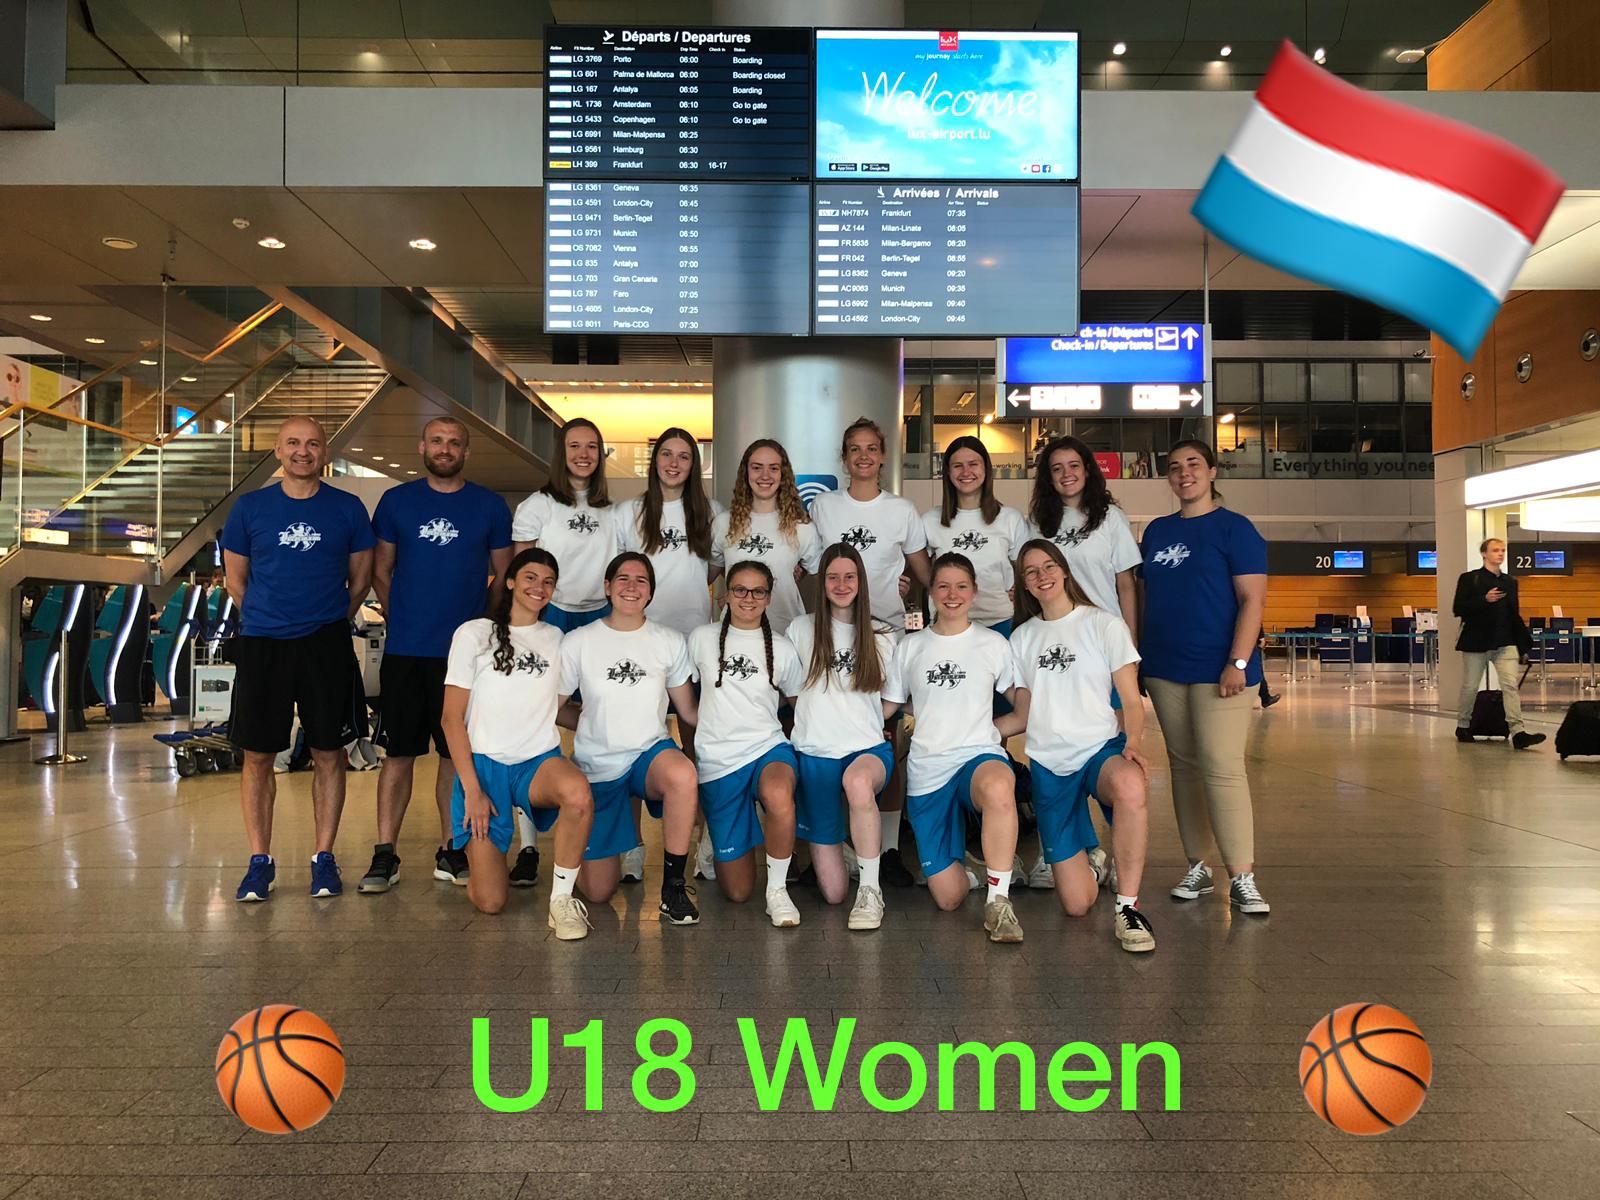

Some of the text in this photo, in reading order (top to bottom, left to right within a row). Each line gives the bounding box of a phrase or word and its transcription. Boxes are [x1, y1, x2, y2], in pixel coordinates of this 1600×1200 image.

[622, 31, 751, 45] Départs / Departures
[573, 55, 583, 63] LG
[733, 57, 762, 65] Boarding
[926, 53, 951, 61] journey
[614, 70, 634, 78] Palma
[636, 70, 644, 78] de
[646, 70, 674, 78] Mallorca
[733, 72, 762, 80] Boarding
[613, 85, 638, 94] Antalya
[733, 87, 762, 95] Boarding
[861, 71, 1037, 117] Welcome
[572, 115, 583, 123] LG
[613, 116, 655, 124] Copenhagen
[613, 131, 665, 139] Milan-Malpensa
[679, 131, 698, 139] 06:25
[613, 146, 644, 154] Hamburg
[679, 146, 698, 154] 06:30
[679, 161, 698, 169] 06:30
[893, 188, 999, 198] Arrivées / Arrivals
[613, 199, 653, 208] London-City
[613, 214, 652, 223] Berlin-Tegel
[613, 229, 637, 237] Munich
[572, 244, 584, 252] OS
[882, 240, 931, 248] Milan-Bergamo
[613, 259, 638, 268] Antalya
[680, 260, 698, 268] 07:00
[881, 255, 920, 263] Berlin-Tegel
[680, 275, 698, 283] 07:00
[881, 300, 933, 308] Milan-Malpensa
[614, 305, 653, 314] London-City
[881, 315, 920, 323] London-City
[679, 321, 698, 329] 07:30
[1080, 326, 1107, 338] ck-in
[1112, 326, 1154, 340] Départs
[1051, 339, 1094, 351] Check-in
[1100, 339, 1154, 352] Departures
[993, 462, 1022, 470] -working
[1273, 457, 1435, 475] Everything you nee
[1315, 556, 1331, 569] 20
[1516, 556, 1532, 569] 22
